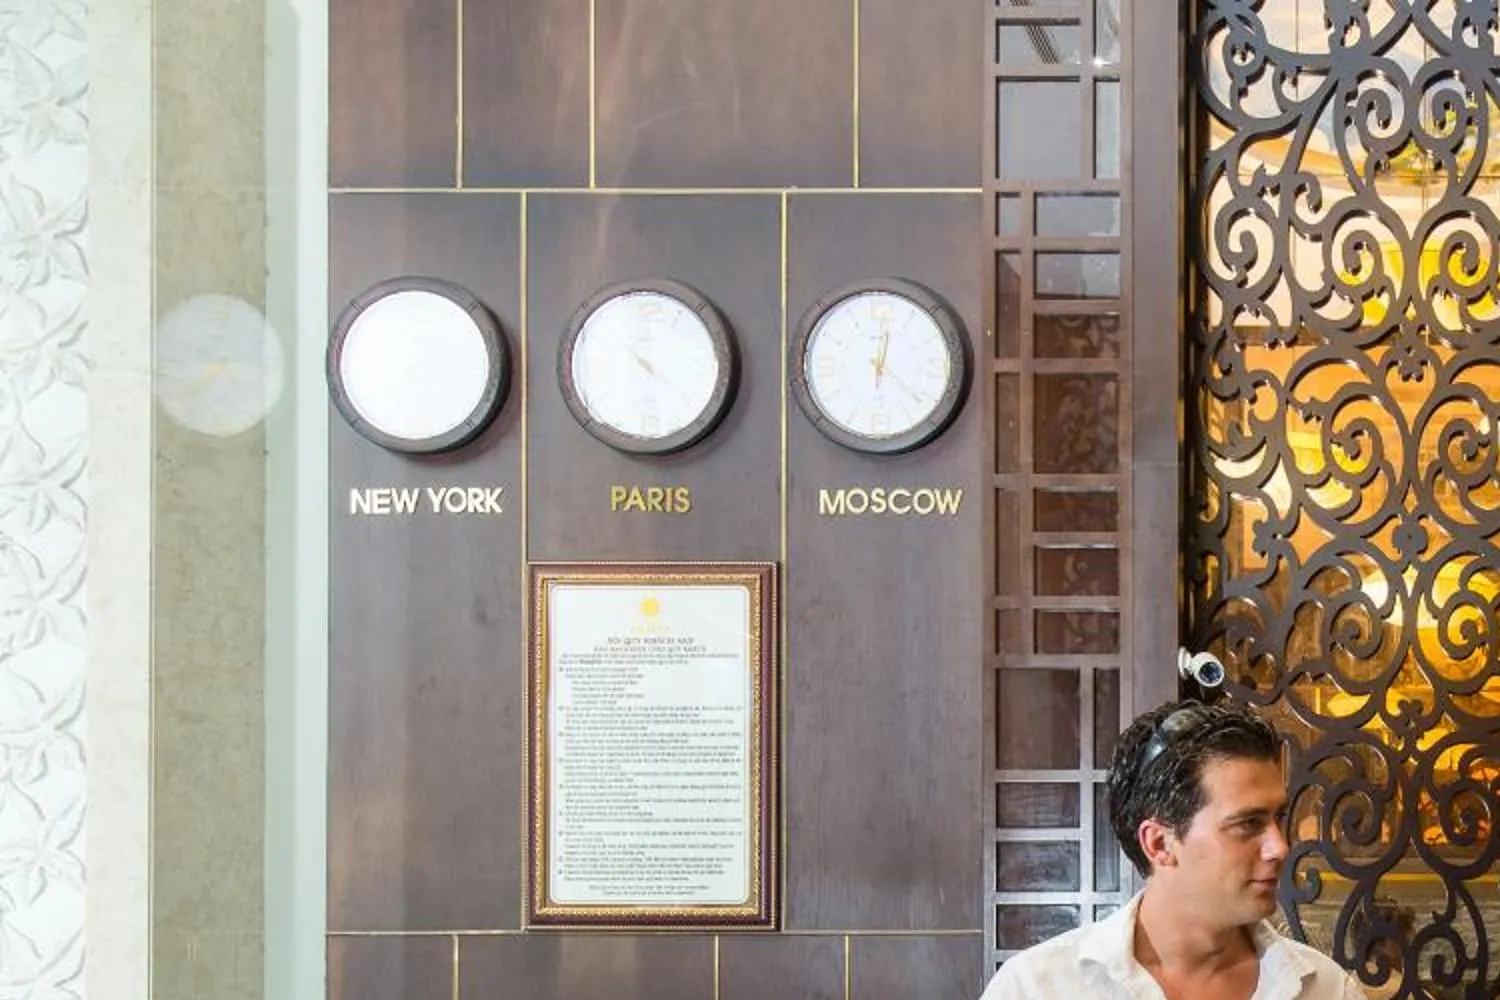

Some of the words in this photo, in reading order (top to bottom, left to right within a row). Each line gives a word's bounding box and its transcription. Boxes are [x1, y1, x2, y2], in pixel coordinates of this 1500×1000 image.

[350, 487, 420, 515] NEW
[426, 486, 504, 514] YORK
[610, 485, 692, 514] PARIS
[818, 487, 964, 515] MOSCOW
